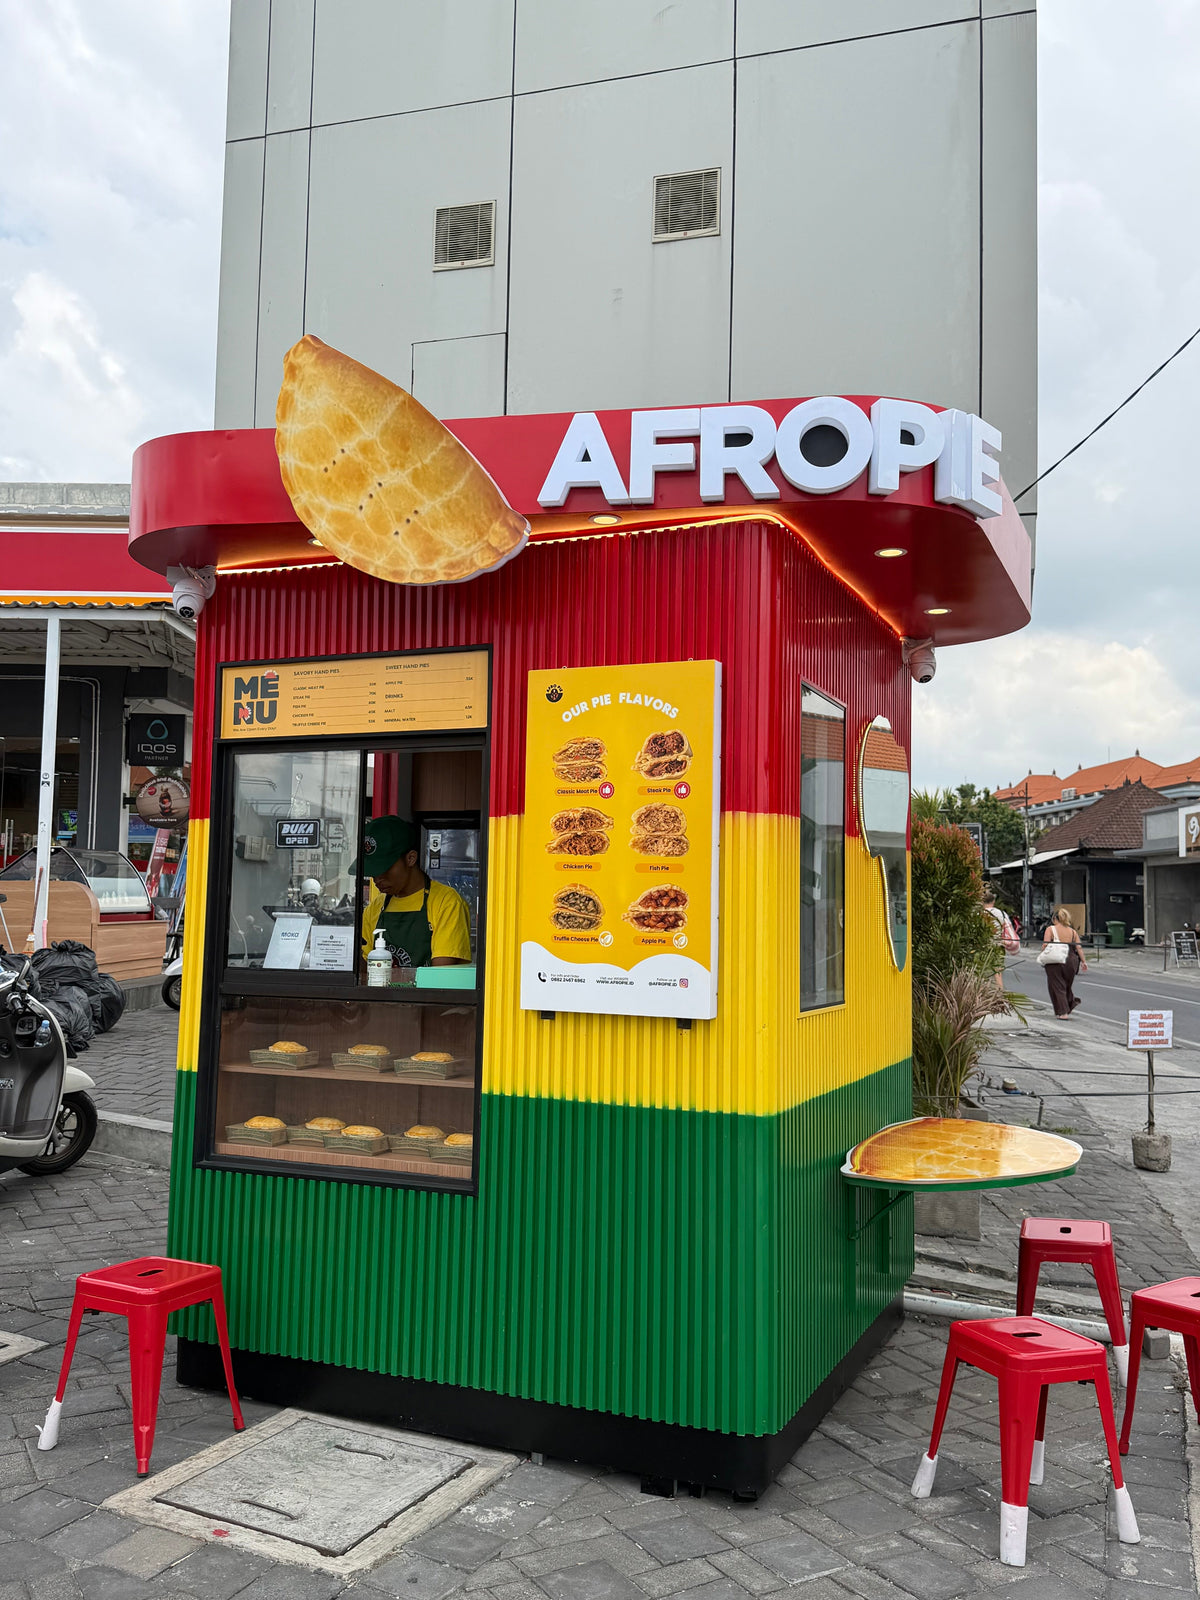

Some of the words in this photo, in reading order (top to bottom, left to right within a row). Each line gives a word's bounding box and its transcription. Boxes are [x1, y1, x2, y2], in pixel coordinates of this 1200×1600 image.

[536, 395, 1002, 518] AFROPIE
[562, 702, 589, 722] OUR
[591, 693, 612, 708] PIE
[618, 692, 679, 719] FLAVORS
[137, 743, 177, 754] IQOS
[281, 823, 314, 834] BUKA
[286, 837, 309, 845] OPEN
[433, 840, 439, 848] 5
[396, 947, 412, 965] PIE
